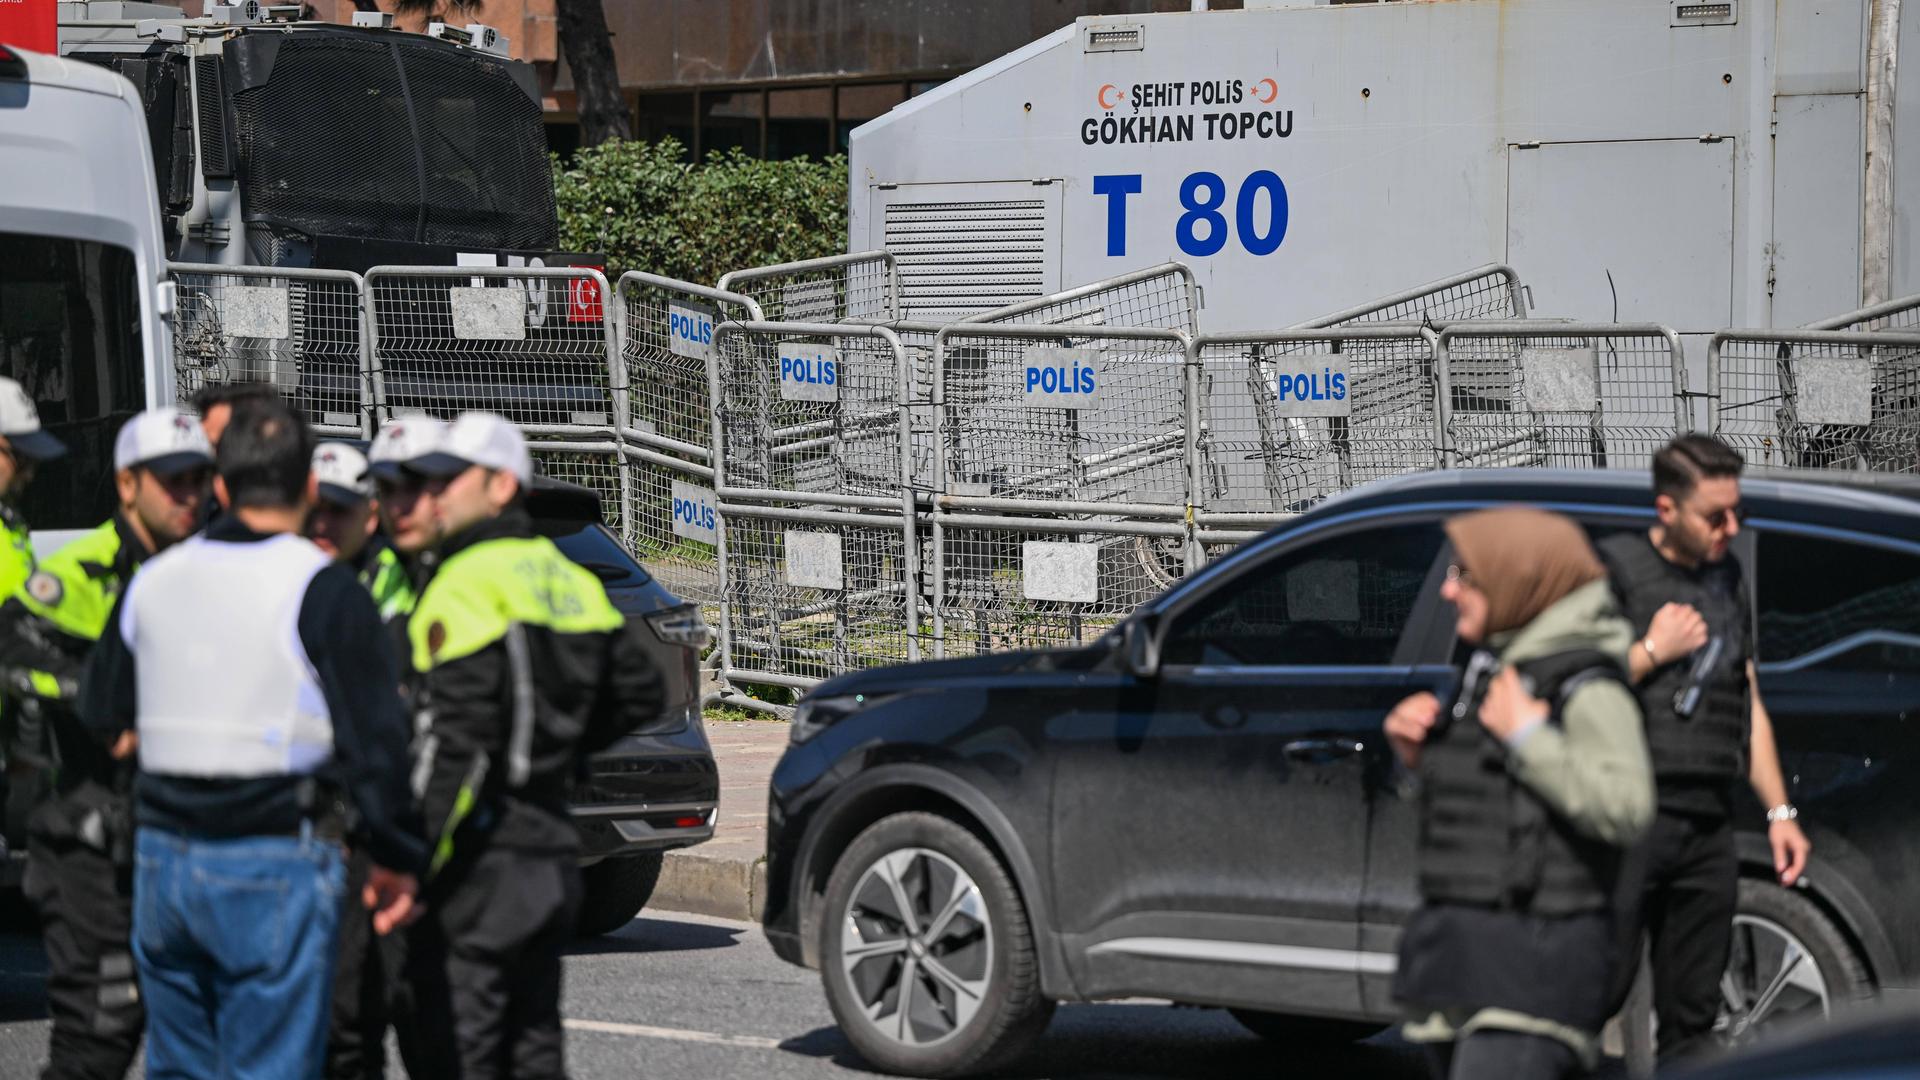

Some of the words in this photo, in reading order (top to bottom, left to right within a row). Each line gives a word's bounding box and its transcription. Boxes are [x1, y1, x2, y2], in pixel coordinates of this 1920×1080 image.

[1081, 112, 1194, 145] GÖKHAN
[1203, 110, 1293, 141] TOPCU
[1092, 173, 1143, 257] T
[1175, 169, 1289, 257] 80
[670, 312, 712, 345] POLİS
[781, 354, 837, 386] POLİS
[1026, 360, 1096, 394] POLİS
[1279, 367, 1346, 401] POLİS
[673, 498, 715, 530] POLİS
